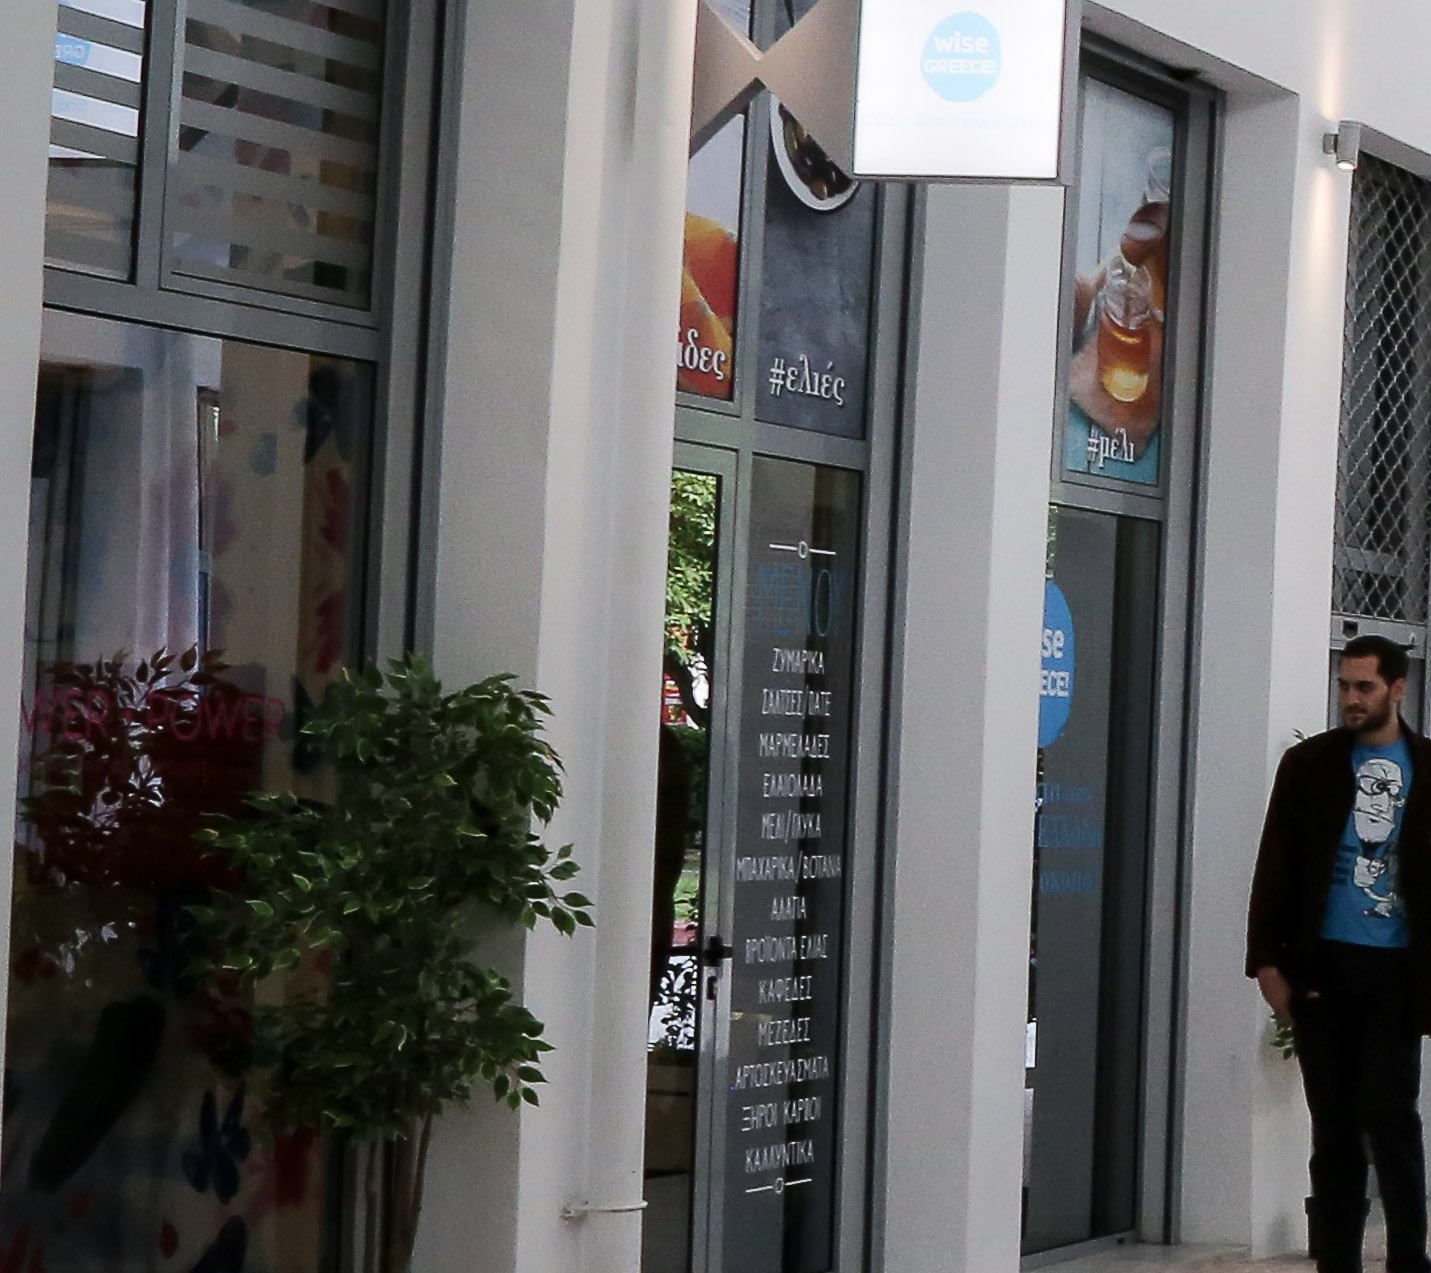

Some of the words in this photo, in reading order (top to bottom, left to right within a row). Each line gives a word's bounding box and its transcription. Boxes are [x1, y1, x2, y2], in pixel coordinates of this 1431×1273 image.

[935, 32, 990, 53] wise
[769, 353, 846, 406] #ελιές
[757, 1017, 811, 1047] ΜΕΖΕΔΕΣ
